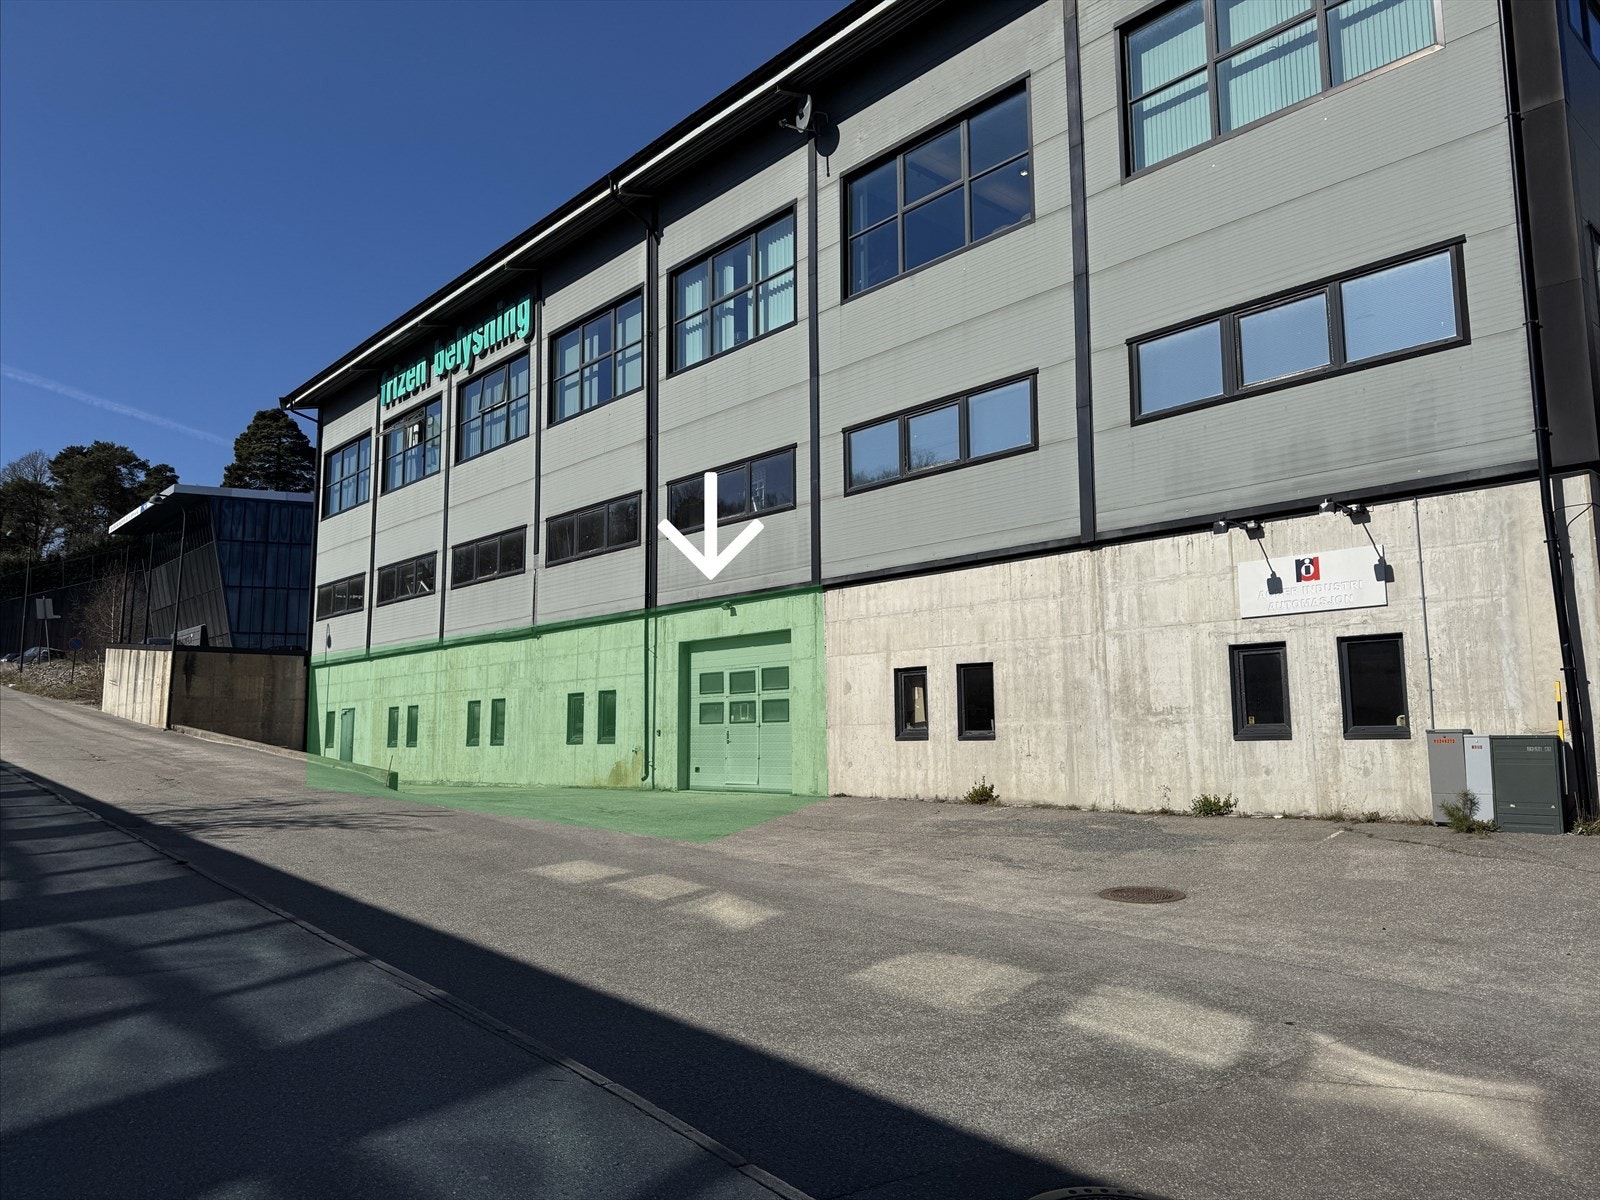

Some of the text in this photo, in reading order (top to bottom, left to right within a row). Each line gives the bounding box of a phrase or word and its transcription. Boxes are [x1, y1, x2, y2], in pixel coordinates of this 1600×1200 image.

[434, 294, 532, 377] belysning
[1257, 579, 1363, 601] AER INDUSTRI
[1268, 594, 1354, 611] AUTOMASJON
